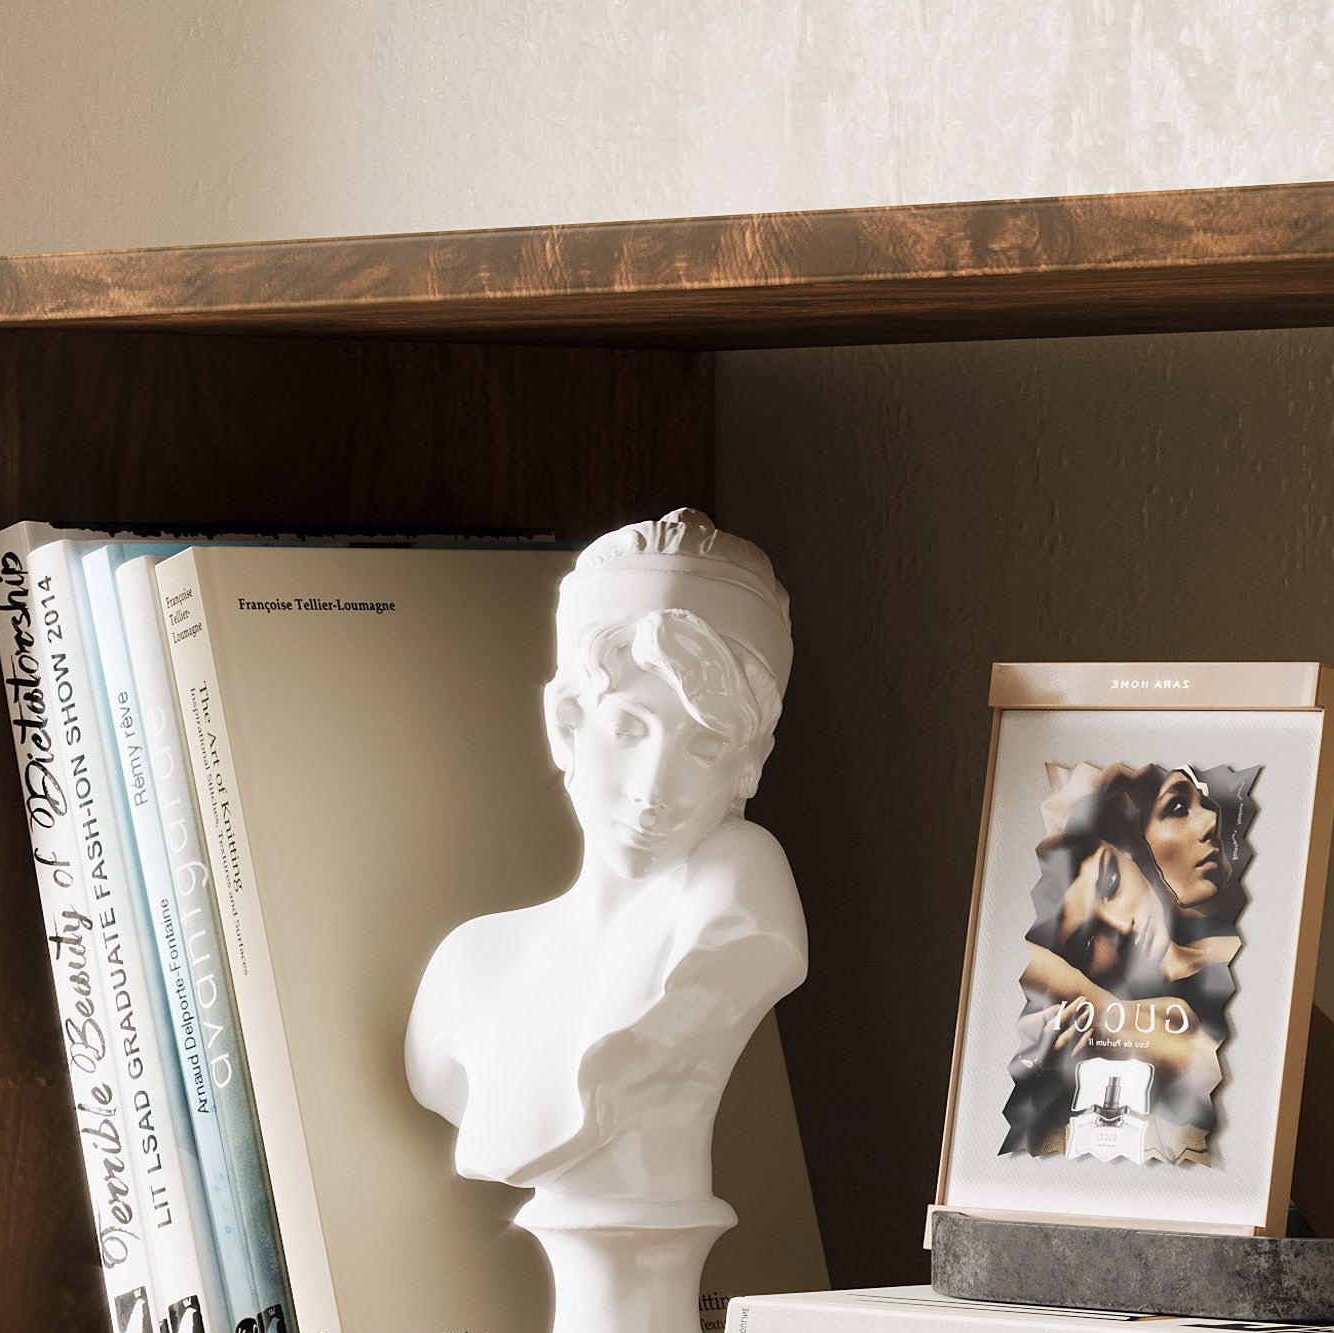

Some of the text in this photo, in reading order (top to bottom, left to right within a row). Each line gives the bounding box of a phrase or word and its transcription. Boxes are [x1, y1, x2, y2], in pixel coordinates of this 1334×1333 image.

[165, 587, 193, 609] Françoise
[172, 622, 203, 644] Loumagne
[238, 598, 396, 615] Françoise Tellier-Loumagne
[118, 691, 148, 807] Rémy rêve
[199, 680, 243, 893] The Art of Knitting
[34, 847, 74, 888] of
[38, 575, 173, 1229] LIT LSAD GRADUATE FASH-ION SHOW 2014
[190, 687, 211, 771] Inspirational
[218, 830, 232, 889] Textures
[229, 892, 239, 916] and
[235, 919, 248, 976] Surfaces
[160, 898, 209, 1114] Arnaud Delporte-Fontaine
[77, 1083, 143, 1269] Terrible
